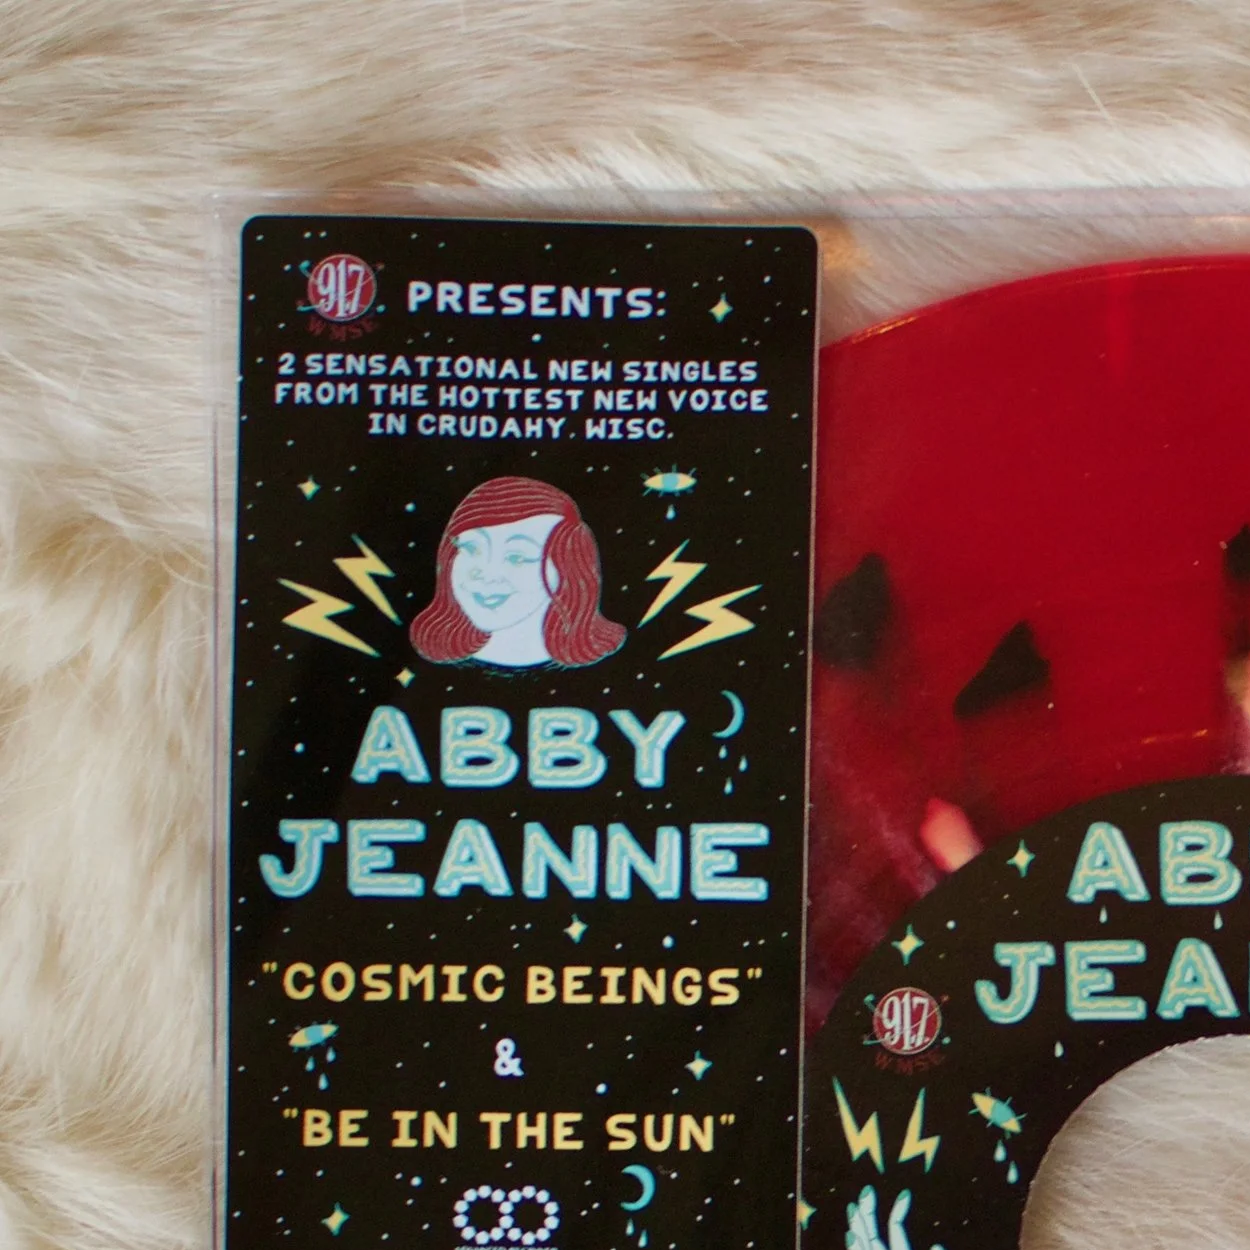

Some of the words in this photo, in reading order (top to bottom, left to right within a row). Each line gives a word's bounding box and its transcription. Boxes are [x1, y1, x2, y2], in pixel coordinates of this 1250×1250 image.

[407, 280, 666, 319] PRESENTS:
[278, 352, 296, 375] 2
[305, 353, 539, 379] SENSATIONAL
[548, 359, 613, 382] NEW
[622, 360, 758, 383] SINGLES
[274, 381, 359, 405] FROM
[369, 383, 429, 407] THE
[439, 385, 584, 411] HOTTEST
[593, 388, 657, 412] NEW
[667, 388, 769, 412] VOICE
[368, 412, 407, 435] IN
[585, 417, 674, 440] WISC.
[351, 705, 687, 790] ABBY
[259, 818, 770, 902] JEANNE
[262, 961, 505, 1003] "COSMIC
[526, 965, 763, 1006] BEINGS"
[493, 1038, 525, 1077] &
[283, 1108, 369, 1147] "BE
[391, 1110, 458, 1149] IN
[479, 1111, 584, 1150] THE
[605, 1113, 735, 1153] SUN"
